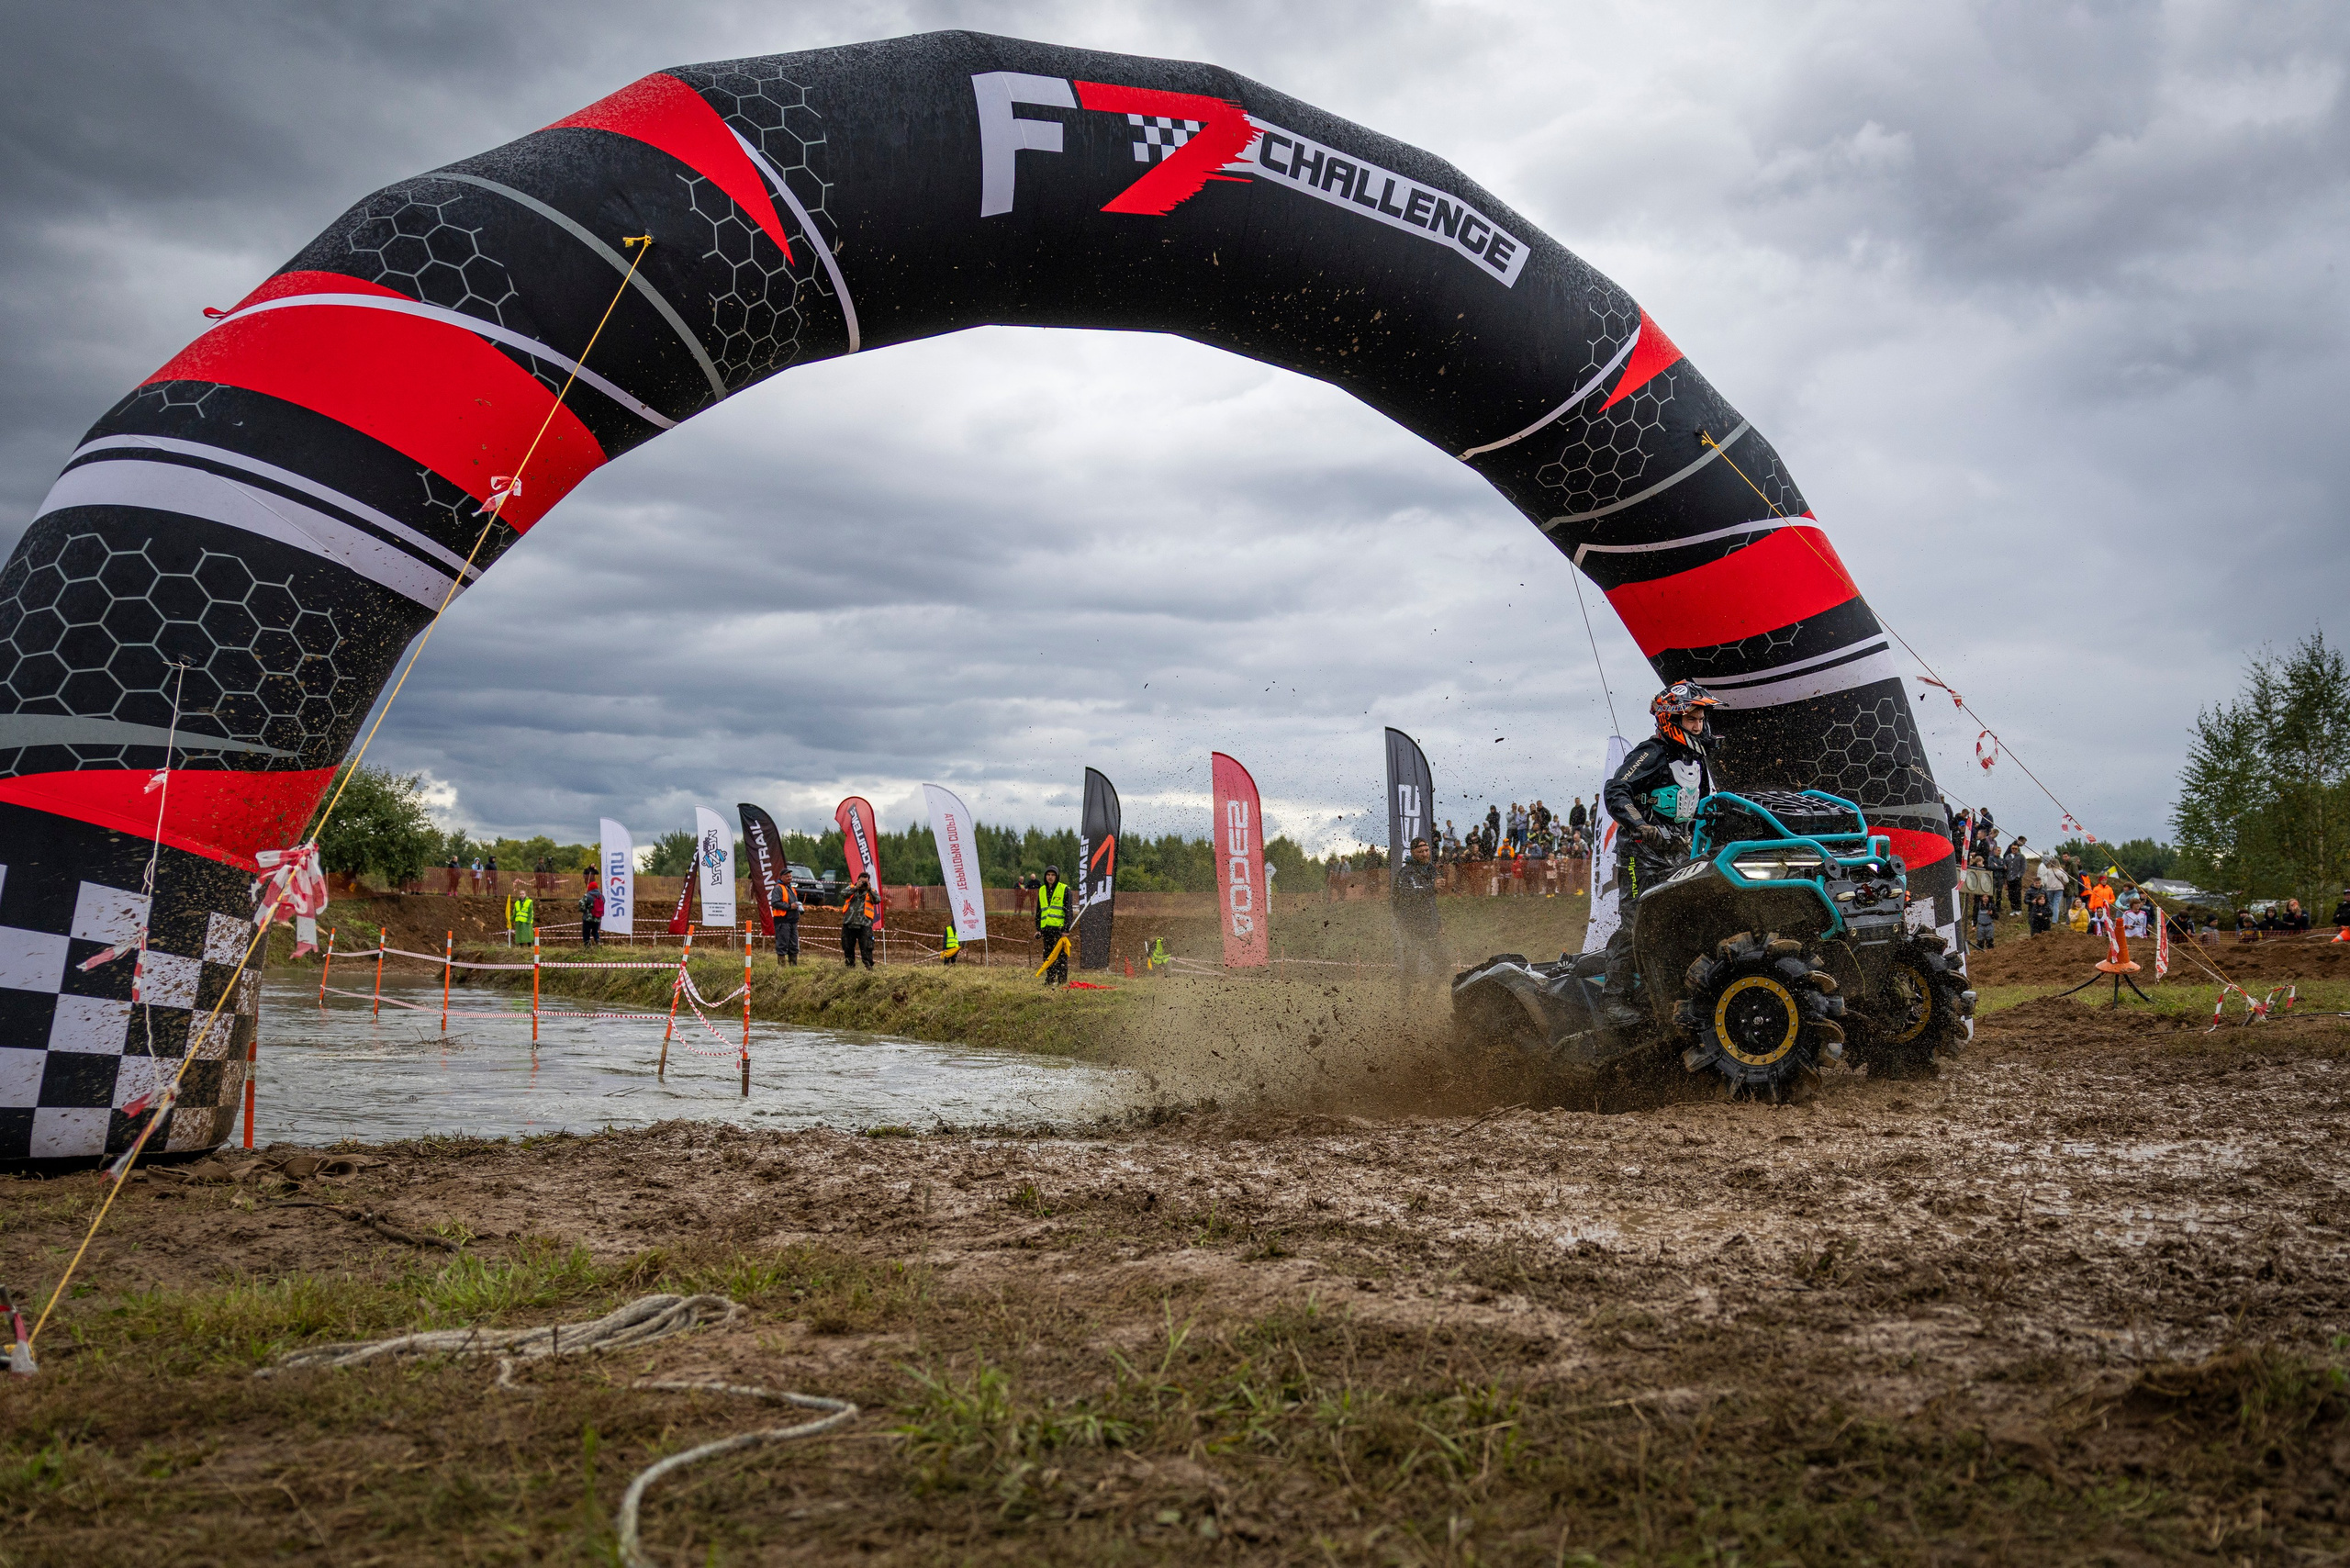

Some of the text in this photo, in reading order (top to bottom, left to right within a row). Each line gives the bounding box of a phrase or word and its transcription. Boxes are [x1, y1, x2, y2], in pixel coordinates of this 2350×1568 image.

[971, 71, 1517, 274] F7 CHALLENGE
[1620, 751, 1650, 781] FINNTRA
